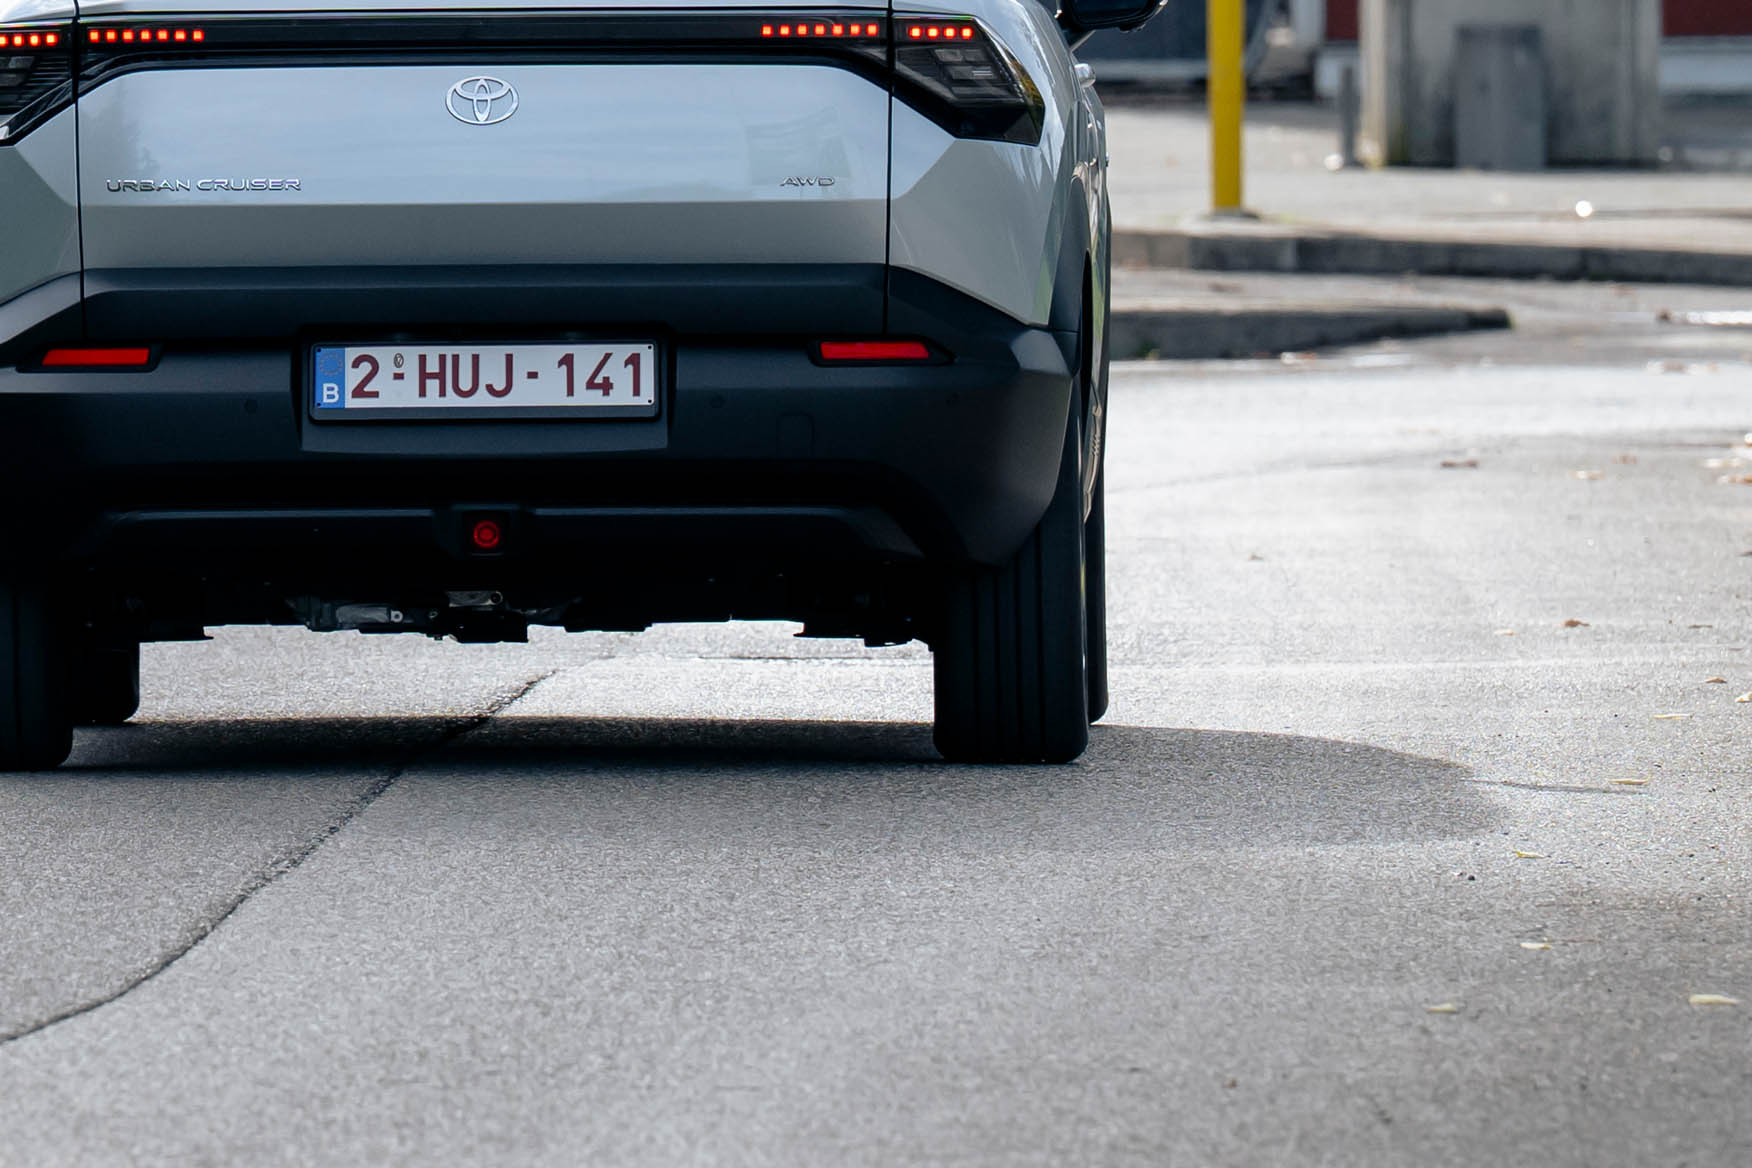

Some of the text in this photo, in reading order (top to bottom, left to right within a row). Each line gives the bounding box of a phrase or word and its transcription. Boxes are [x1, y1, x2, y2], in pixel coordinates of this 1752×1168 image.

[106, 178, 302, 193] URBAN CRUISER
[779, 176, 836, 187] AWD
[322, 382, 340, 403] B
